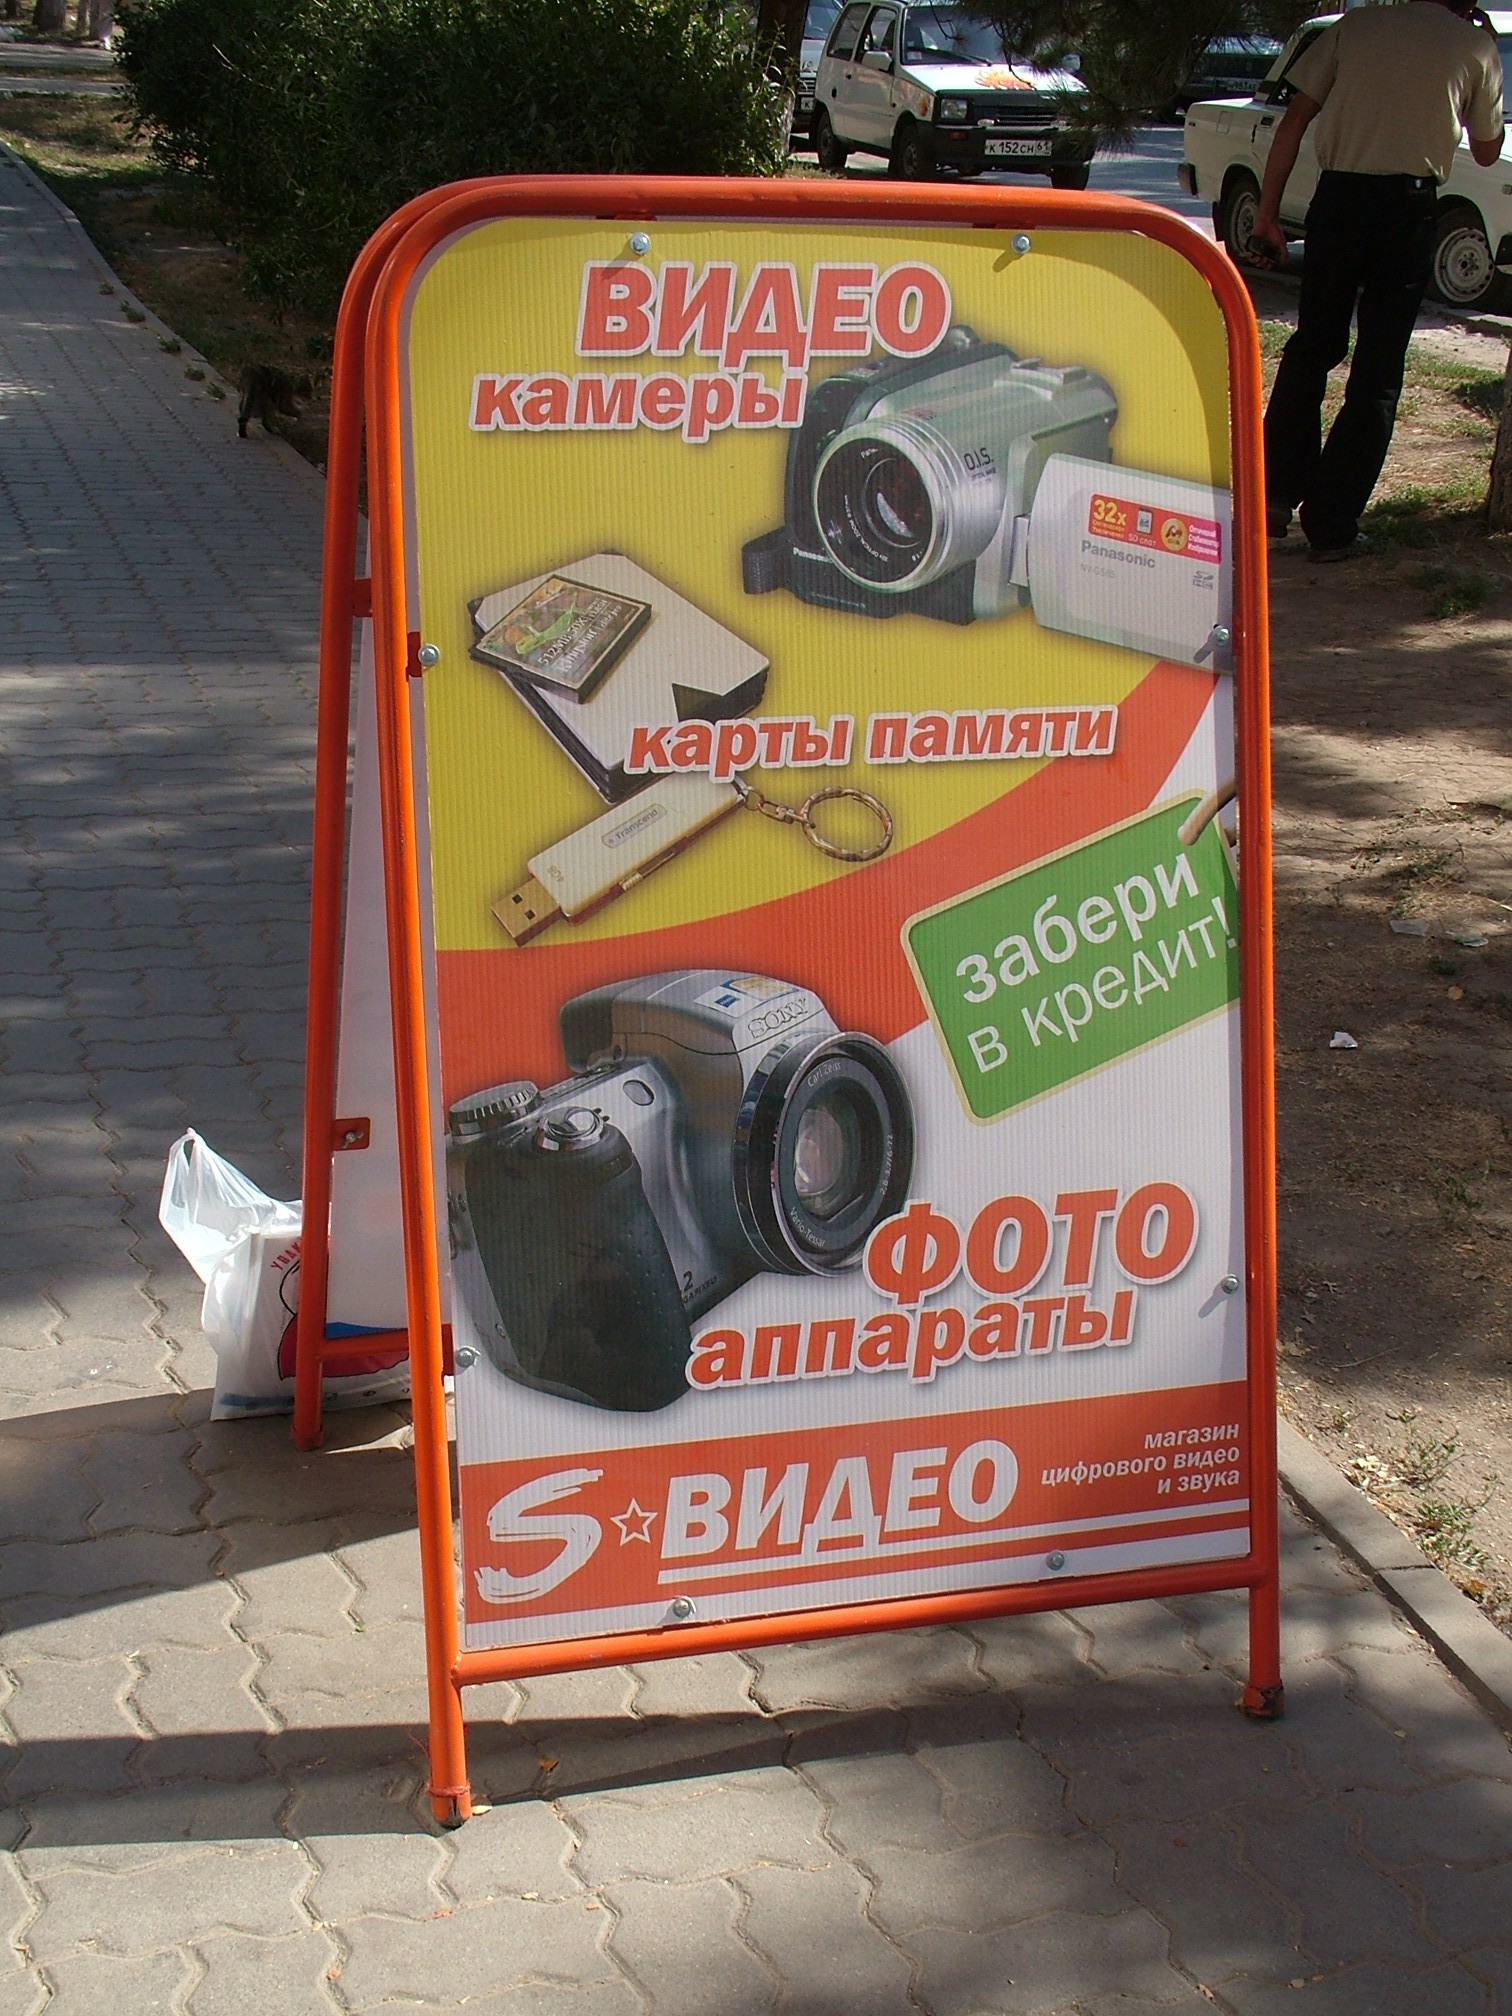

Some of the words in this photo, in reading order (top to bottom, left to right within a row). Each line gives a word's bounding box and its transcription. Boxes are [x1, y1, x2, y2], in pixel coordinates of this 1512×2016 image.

[577, 262, 948, 370] ВИДЕО
[471, 375, 806, 441] камеры
[963, 447, 994, 471] O.I.S.
[1093, 499, 1127, 526] 32x
[1081, 540, 1156, 568] Panasonic
[627, 717, 851, 780] карты
[867, 706, 1116, 762] памяти
[615, 809, 658, 840] Transcend
[956, 853, 1199, 1003] забери
[967, 1025, 1008, 1074] в
[1021, 896, 1237, 1047] кредит!
[748, 998, 808, 1038] SONY
[807, 1067, 823, 1087] Carl
[823, 1062, 841, 1075] Zeiss
[790, 1205, 825, 1247] Vario-Tessar
[866, 1183, 1197, 1305] ФОТО
[688, 1289, 1135, 1387] аппараты
[1144, 1423, 1239, 1449] магазин
[1041, 1455, 1167, 1487] цифрового
[1173, 1446, 1240, 1469] видео
[1157, 1477, 1171, 1494] и
[1177, 1469, 1240, 1493] звука
[660, 1440, 1019, 1562] ВИДЕО
